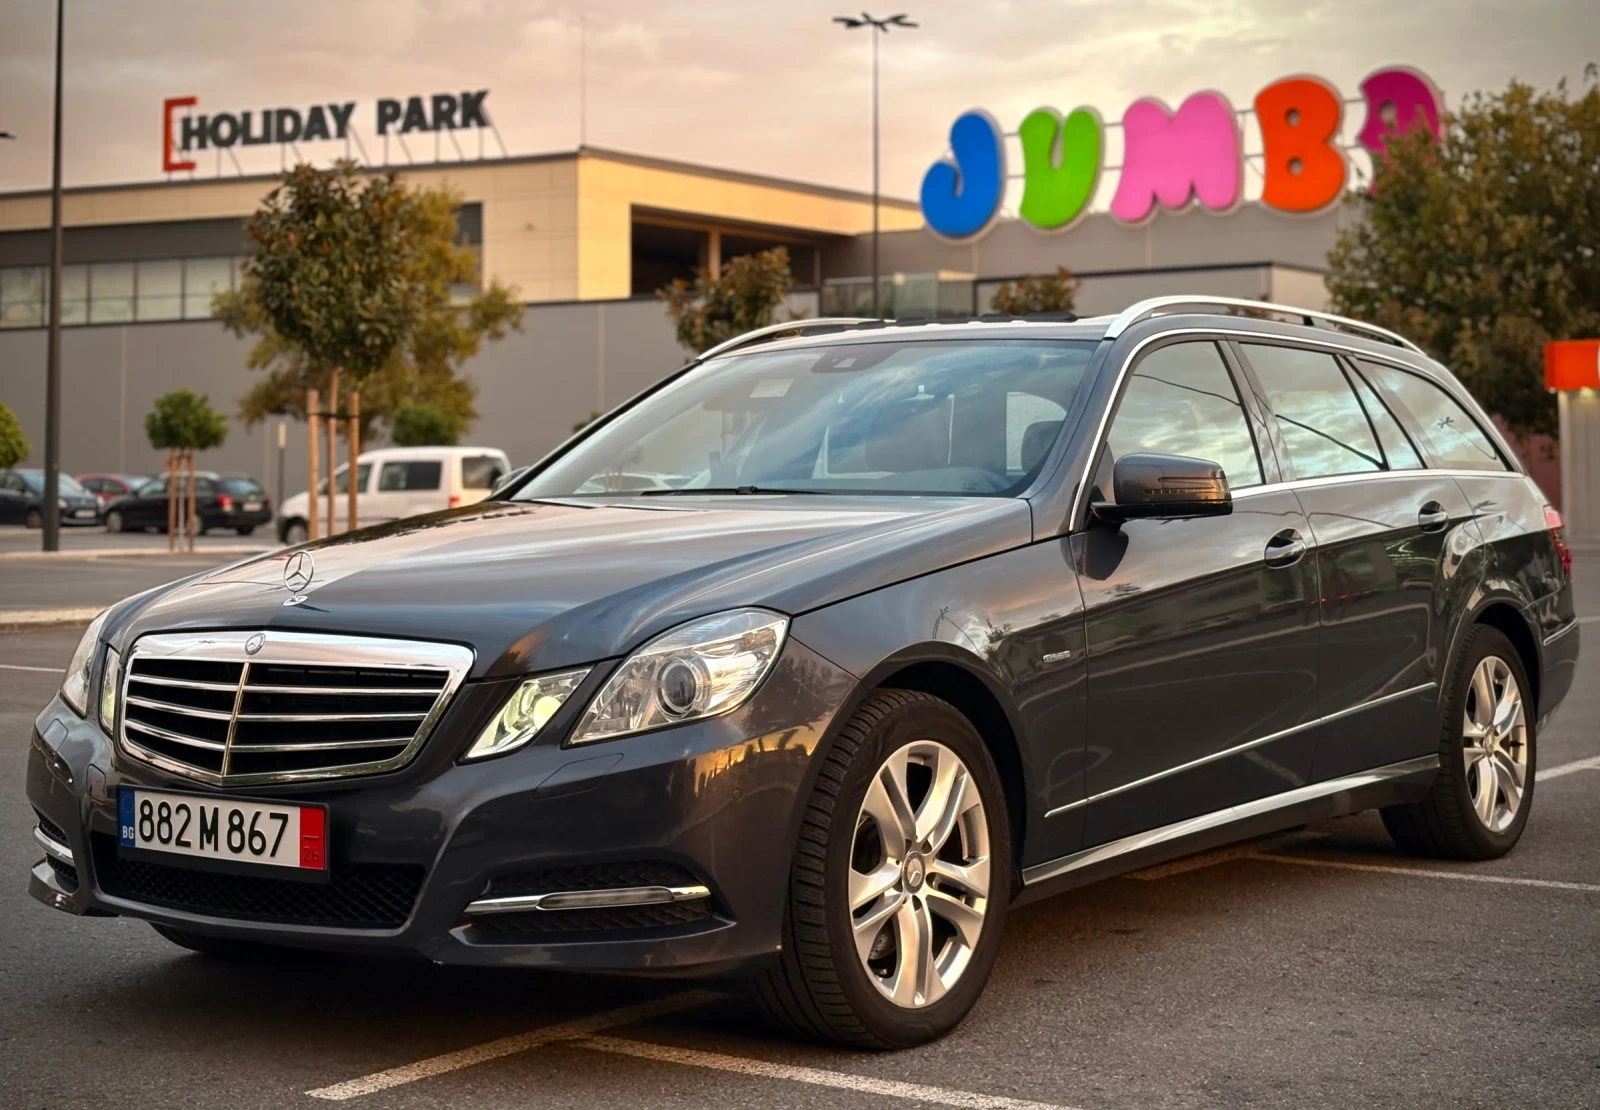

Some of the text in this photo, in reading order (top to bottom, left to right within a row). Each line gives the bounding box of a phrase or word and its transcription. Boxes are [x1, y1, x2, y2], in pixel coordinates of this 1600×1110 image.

[181, 89, 489, 151] HOLIDAY PARK
[122, 825, 134, 840] BG
[139, 799, 192, 848] 882
[227, 808, 289, 857] 867
